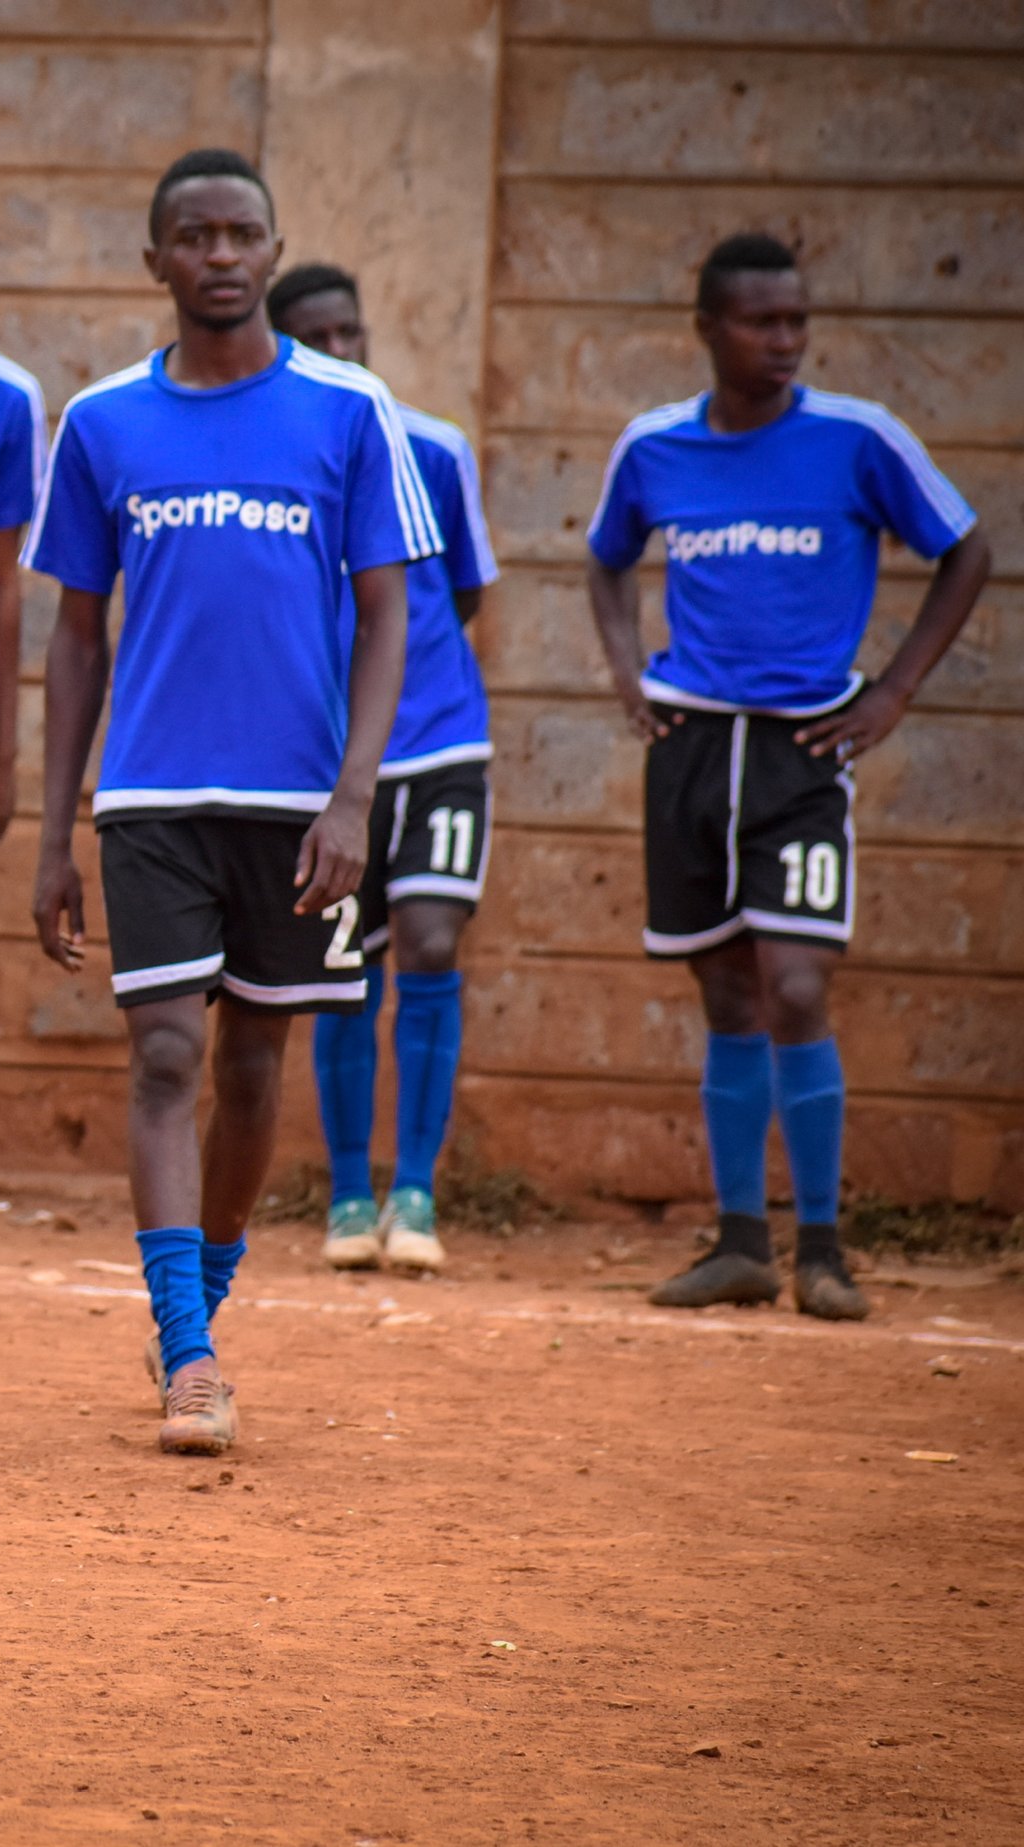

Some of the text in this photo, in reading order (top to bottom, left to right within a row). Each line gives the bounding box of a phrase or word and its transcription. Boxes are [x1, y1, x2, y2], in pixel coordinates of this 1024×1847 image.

[127, 490, 311, 540] SportPesa
[429, 808, 474, 875] 11
[779, 842, 840, 910] 10
[321, 894, 364, 969] 2
